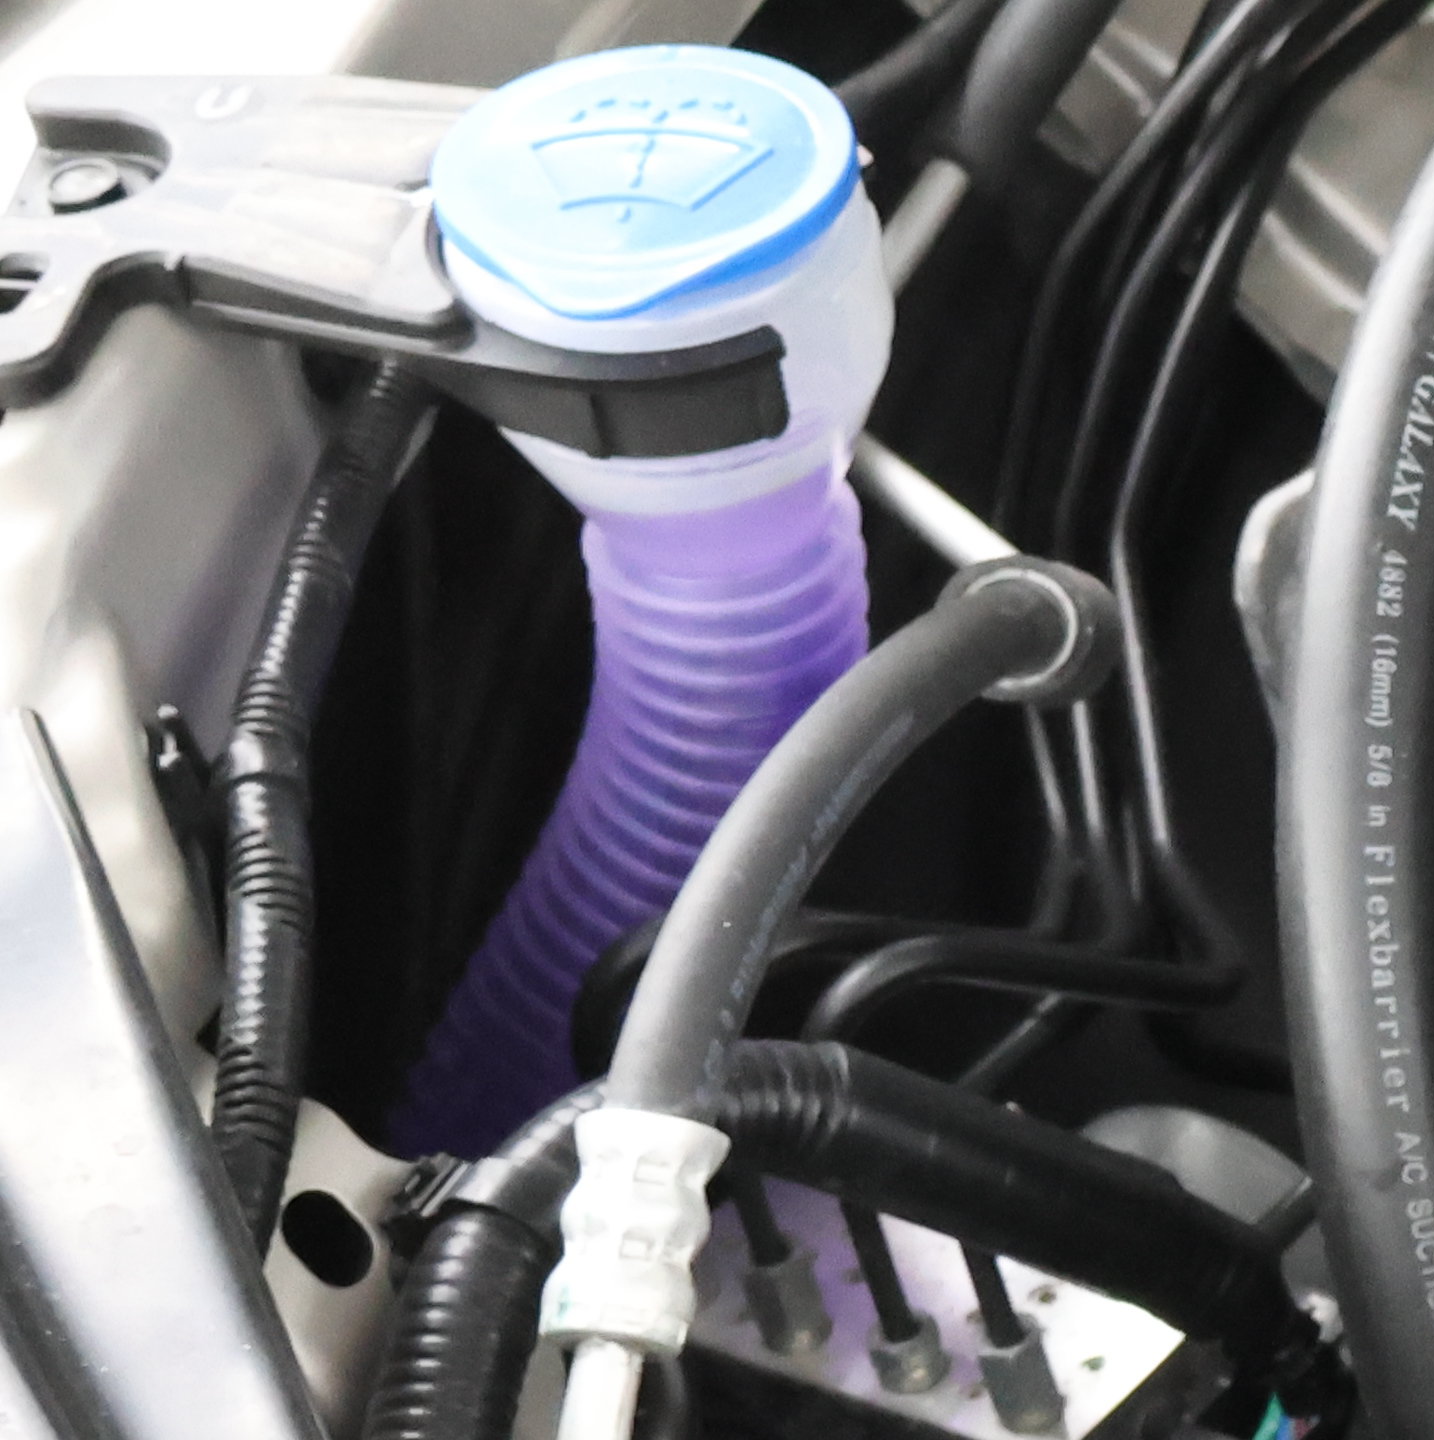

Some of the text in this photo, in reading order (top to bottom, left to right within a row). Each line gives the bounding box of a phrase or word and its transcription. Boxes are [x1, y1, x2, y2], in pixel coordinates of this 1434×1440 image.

[1375, 550, 1408, 618] 4882
[1365, 634, 1400, 728] (16mm)
[1366, 743, 1393, 788] 5/8
[1367, 805, 1390, 827] in
[1363, 845, 1410, 1112] Flexbarrier
[1394, 1130, 1428, 1185] A/C
